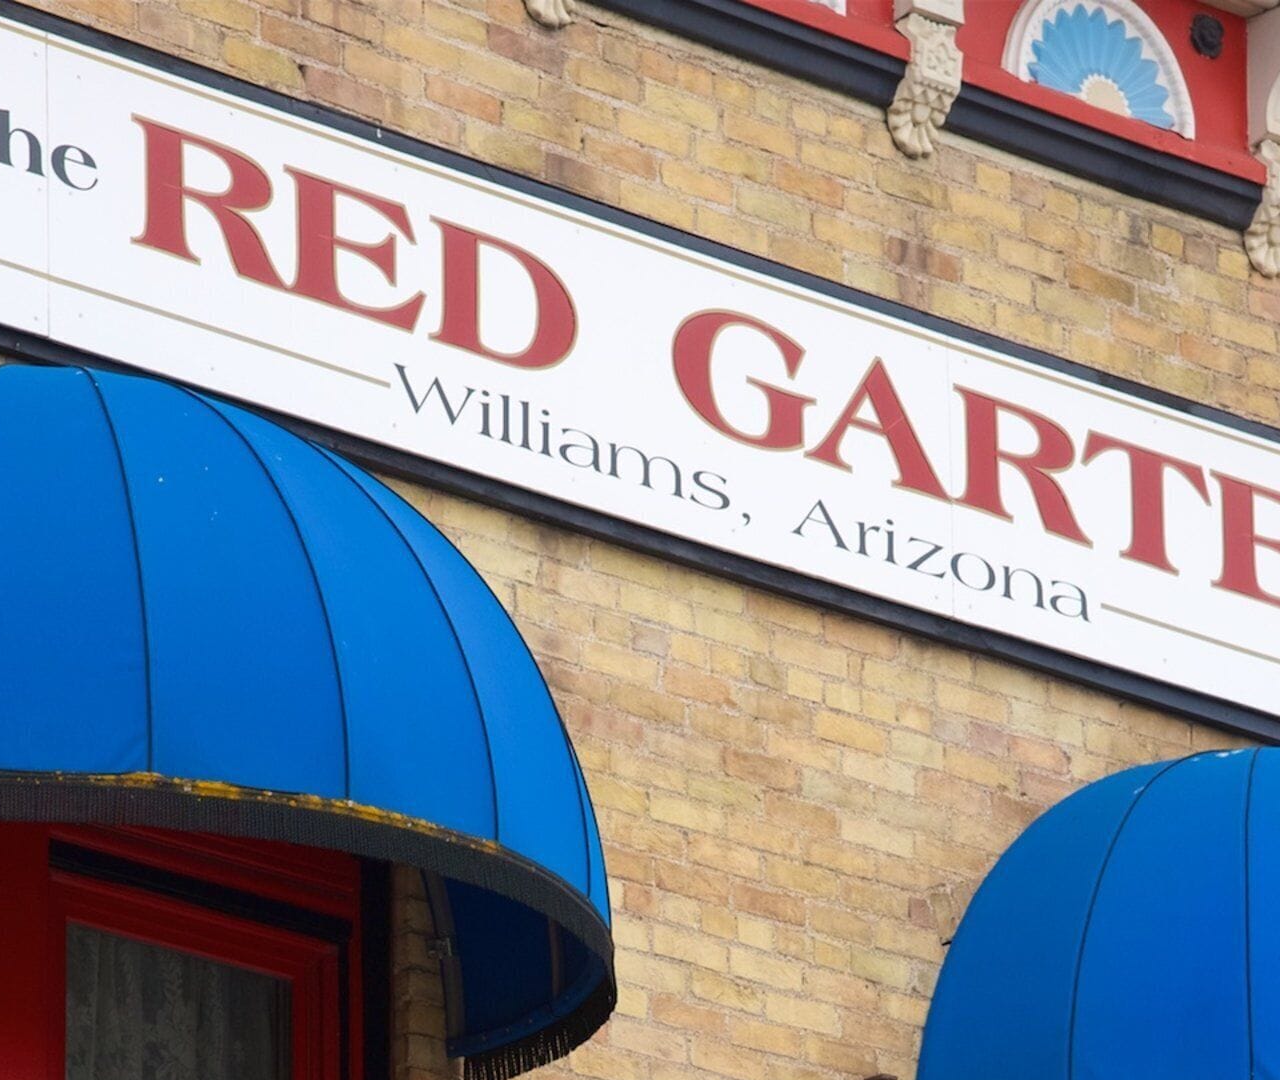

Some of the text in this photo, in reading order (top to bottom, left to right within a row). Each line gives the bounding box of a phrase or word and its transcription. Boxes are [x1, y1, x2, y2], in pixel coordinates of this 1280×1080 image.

[130, 112, 579, 371] RED
[392, 362, 1091, 623] Williams, Arizona
